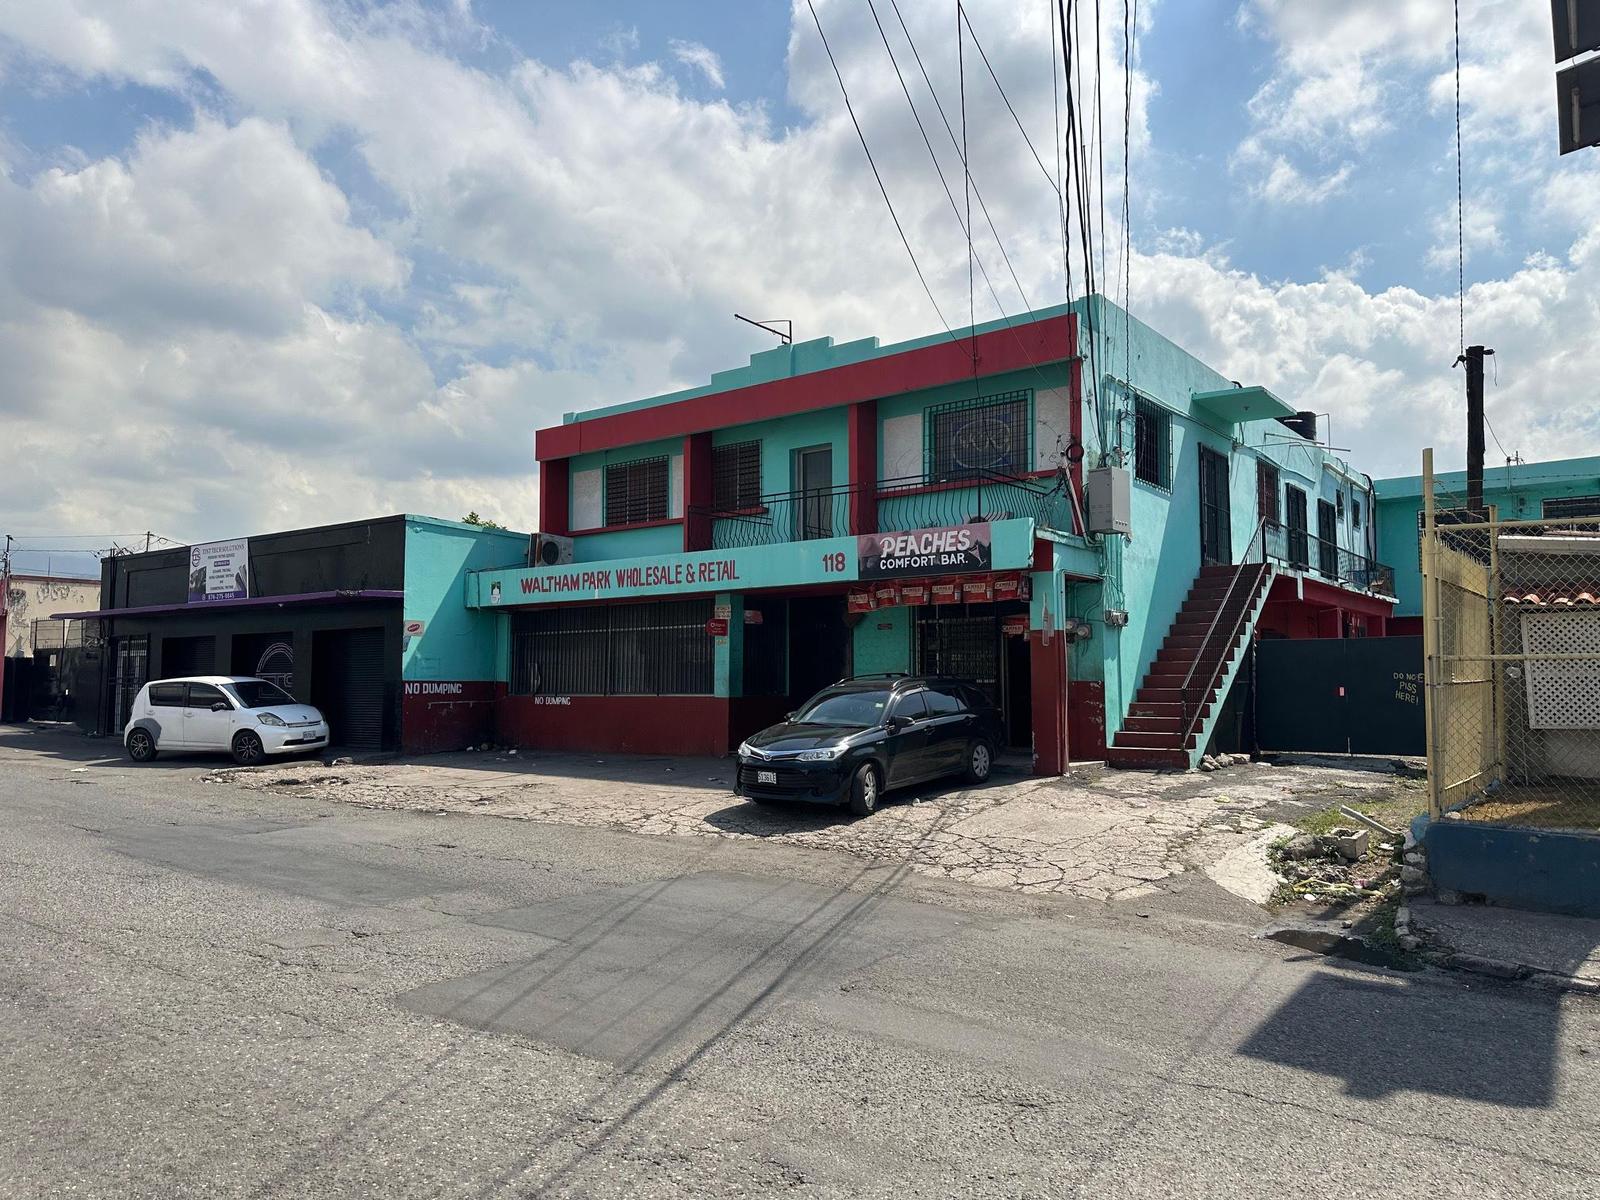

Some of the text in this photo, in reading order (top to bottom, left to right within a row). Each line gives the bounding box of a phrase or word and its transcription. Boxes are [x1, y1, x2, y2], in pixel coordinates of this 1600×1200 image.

[880, 530, 970, 558] PEACHES
[822, 552, 846, 573] 118
[880, 552, 969, 570] COMFORT BAR.
[520, 559, 740, 594] WALTHAM PARK WHOLESALE & RETAIL
[1393, 672, 1404, 680] DO
[405, 683, 463, 695] NO DUMPING
[1400, 681, 1417, 694] PISS
[534, 696, 571, 706] NO DUMPING
